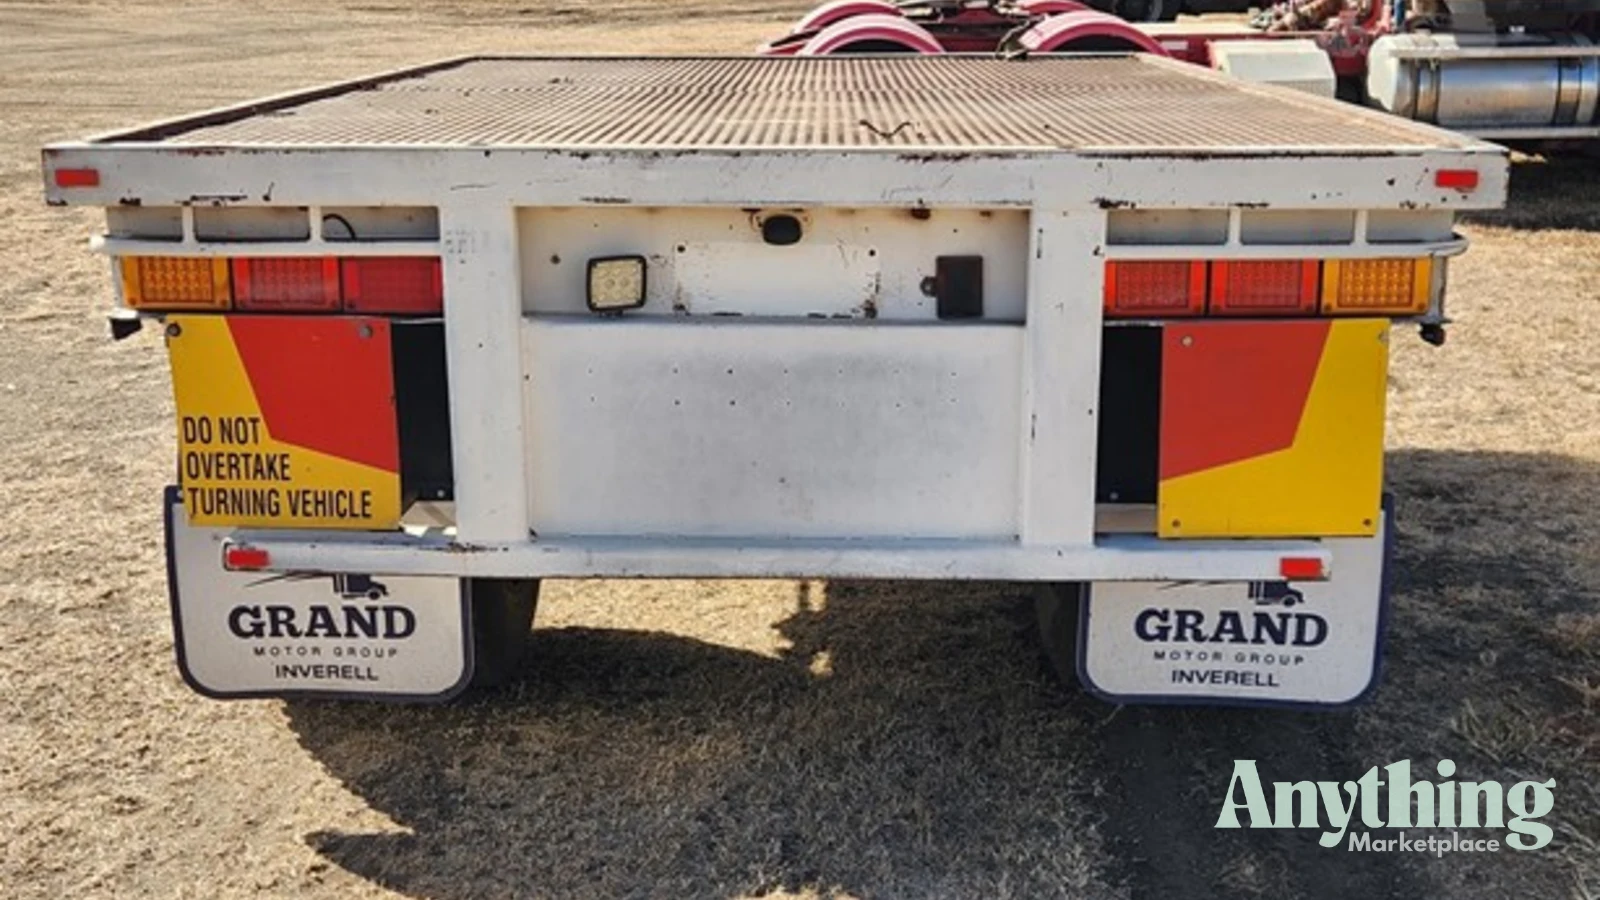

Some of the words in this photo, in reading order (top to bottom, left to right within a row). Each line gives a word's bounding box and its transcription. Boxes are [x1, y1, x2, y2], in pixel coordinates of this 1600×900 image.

[184, 417, 212, 444] DO
[219, 417, 260, 445] NOT
[186, 451, 291, 481] OVERTAKE
[188, 487, 280, 516] TURNING
[288, 489, 371, 518] VEHICLE
[228, 605, 416, 639] GRAND
[1134, 608, 1328, 647] GRAND
[254, 646, 321, 656] MOTOR
[335, 647, 398, 658] GROUP
[1154, 650, 1223, 661] MOTOR
[1235, 652, 1304, 666] GROUP
[275, 664, 379, 680] INVERELL
[1171, 669, 1279, 687] INVERELL
